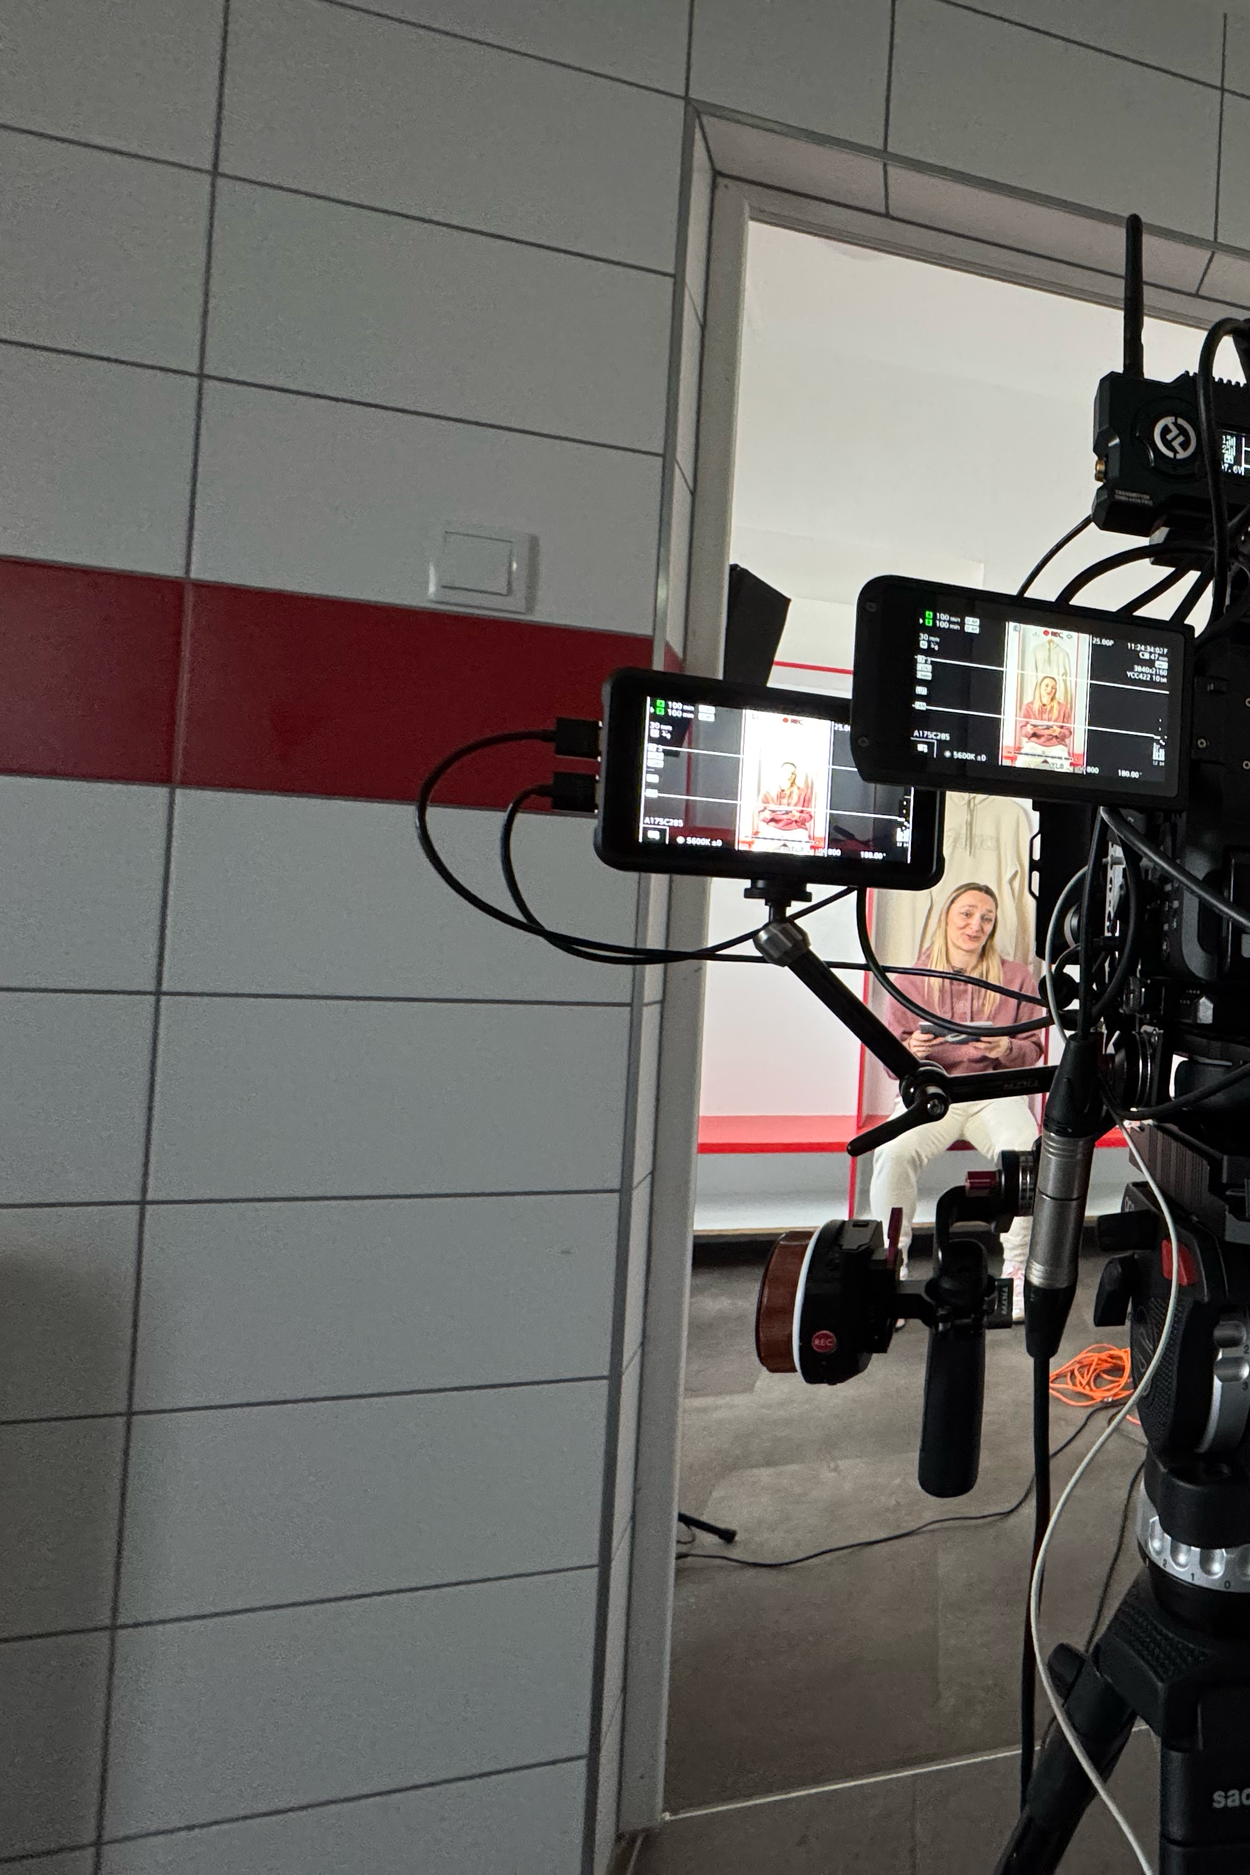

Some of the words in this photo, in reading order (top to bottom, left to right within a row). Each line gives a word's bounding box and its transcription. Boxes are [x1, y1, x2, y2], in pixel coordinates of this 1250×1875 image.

[936, 612, 950, 621] 100
[936, 620, 949, 629] 100
[919, 633, 929, 641] 30
[1134, 665, 1168, 676] 3840x2160
[1126, 671, 1151, 681] YCC422
[913, 729, 951, 741] A175C285
[953, 750, 976, 761] 5600K
[644, 816, 684, 828] A175C285
[814, 1337, 834, 1346] REC
[1243, 1344, 1250, 1354] 2
[1242, 1381, 1249, 1391] 3
[1162, 1558, 1168, 1568] 2
[1224, 1580, 1231, 1589] 0
